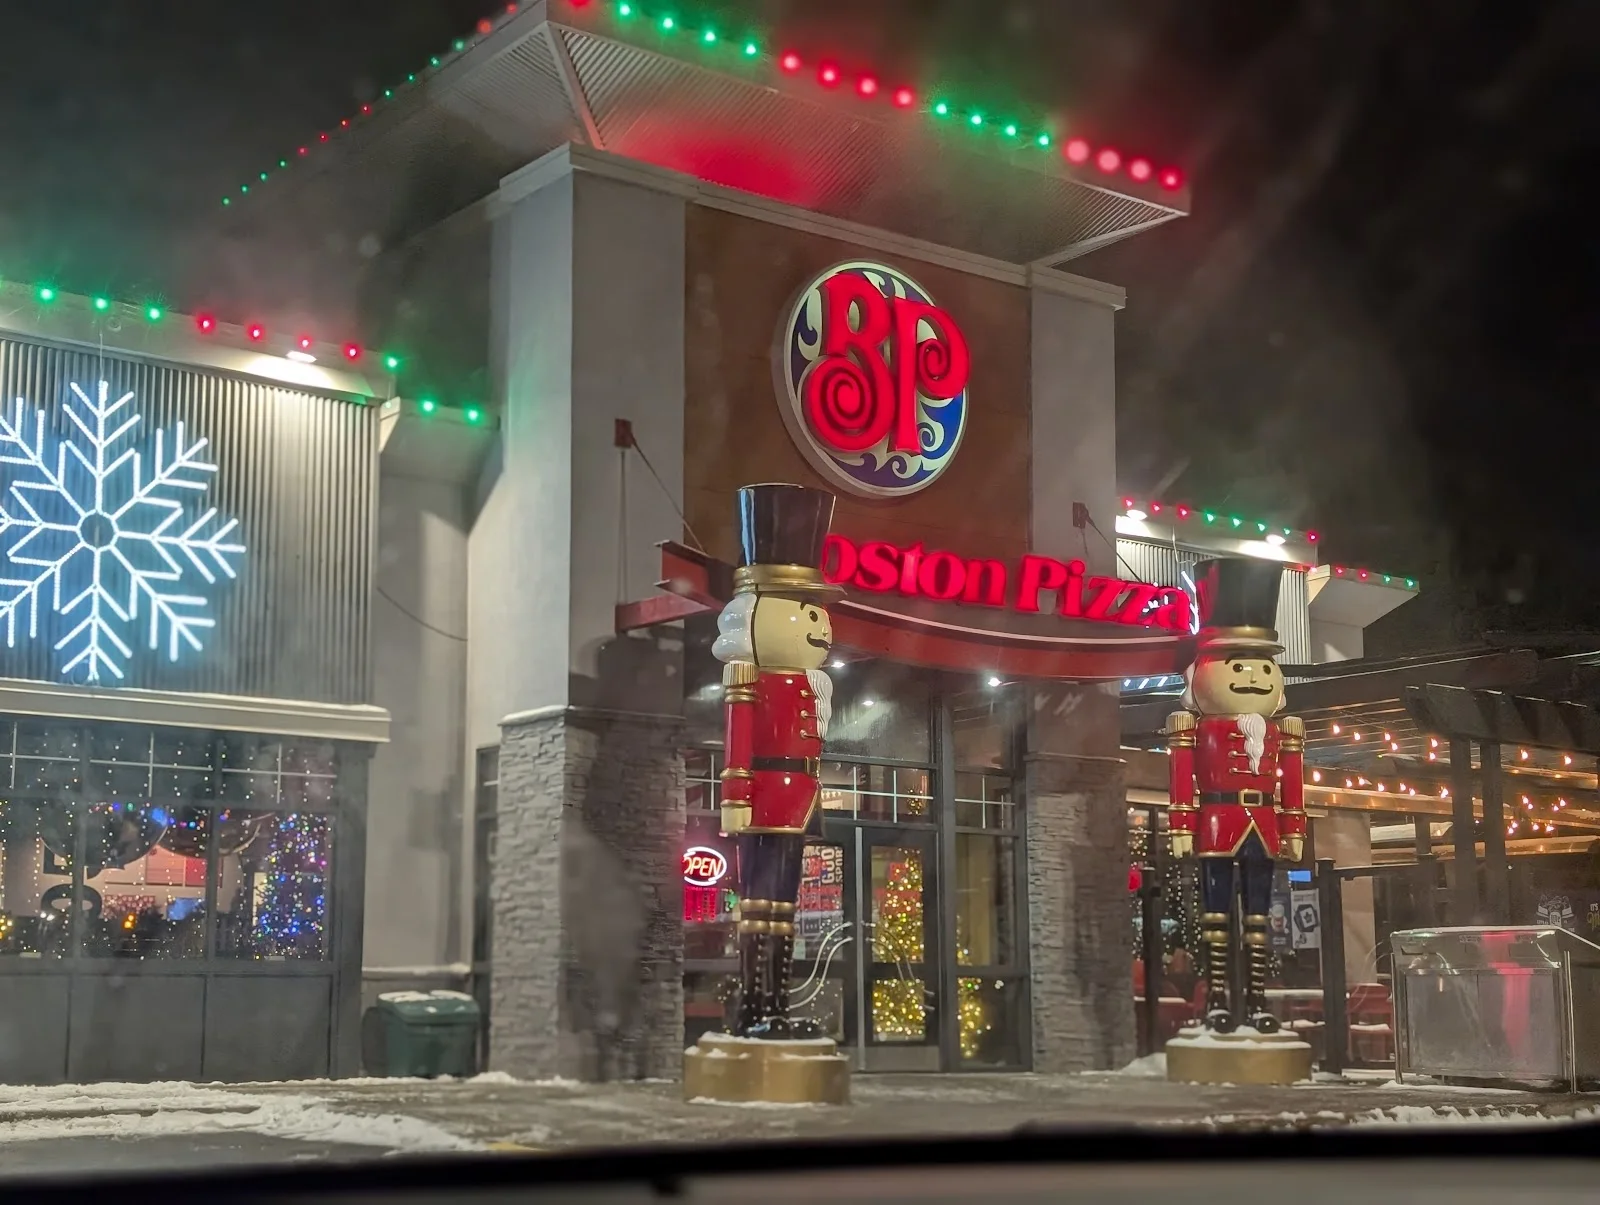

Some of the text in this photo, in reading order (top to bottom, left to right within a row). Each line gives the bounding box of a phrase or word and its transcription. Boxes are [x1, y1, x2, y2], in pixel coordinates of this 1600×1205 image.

[804, 272, 970, 454] BP
[821, 532, 1191, 631] oston Pizza
[682, 855, 722, 877] OPEN
